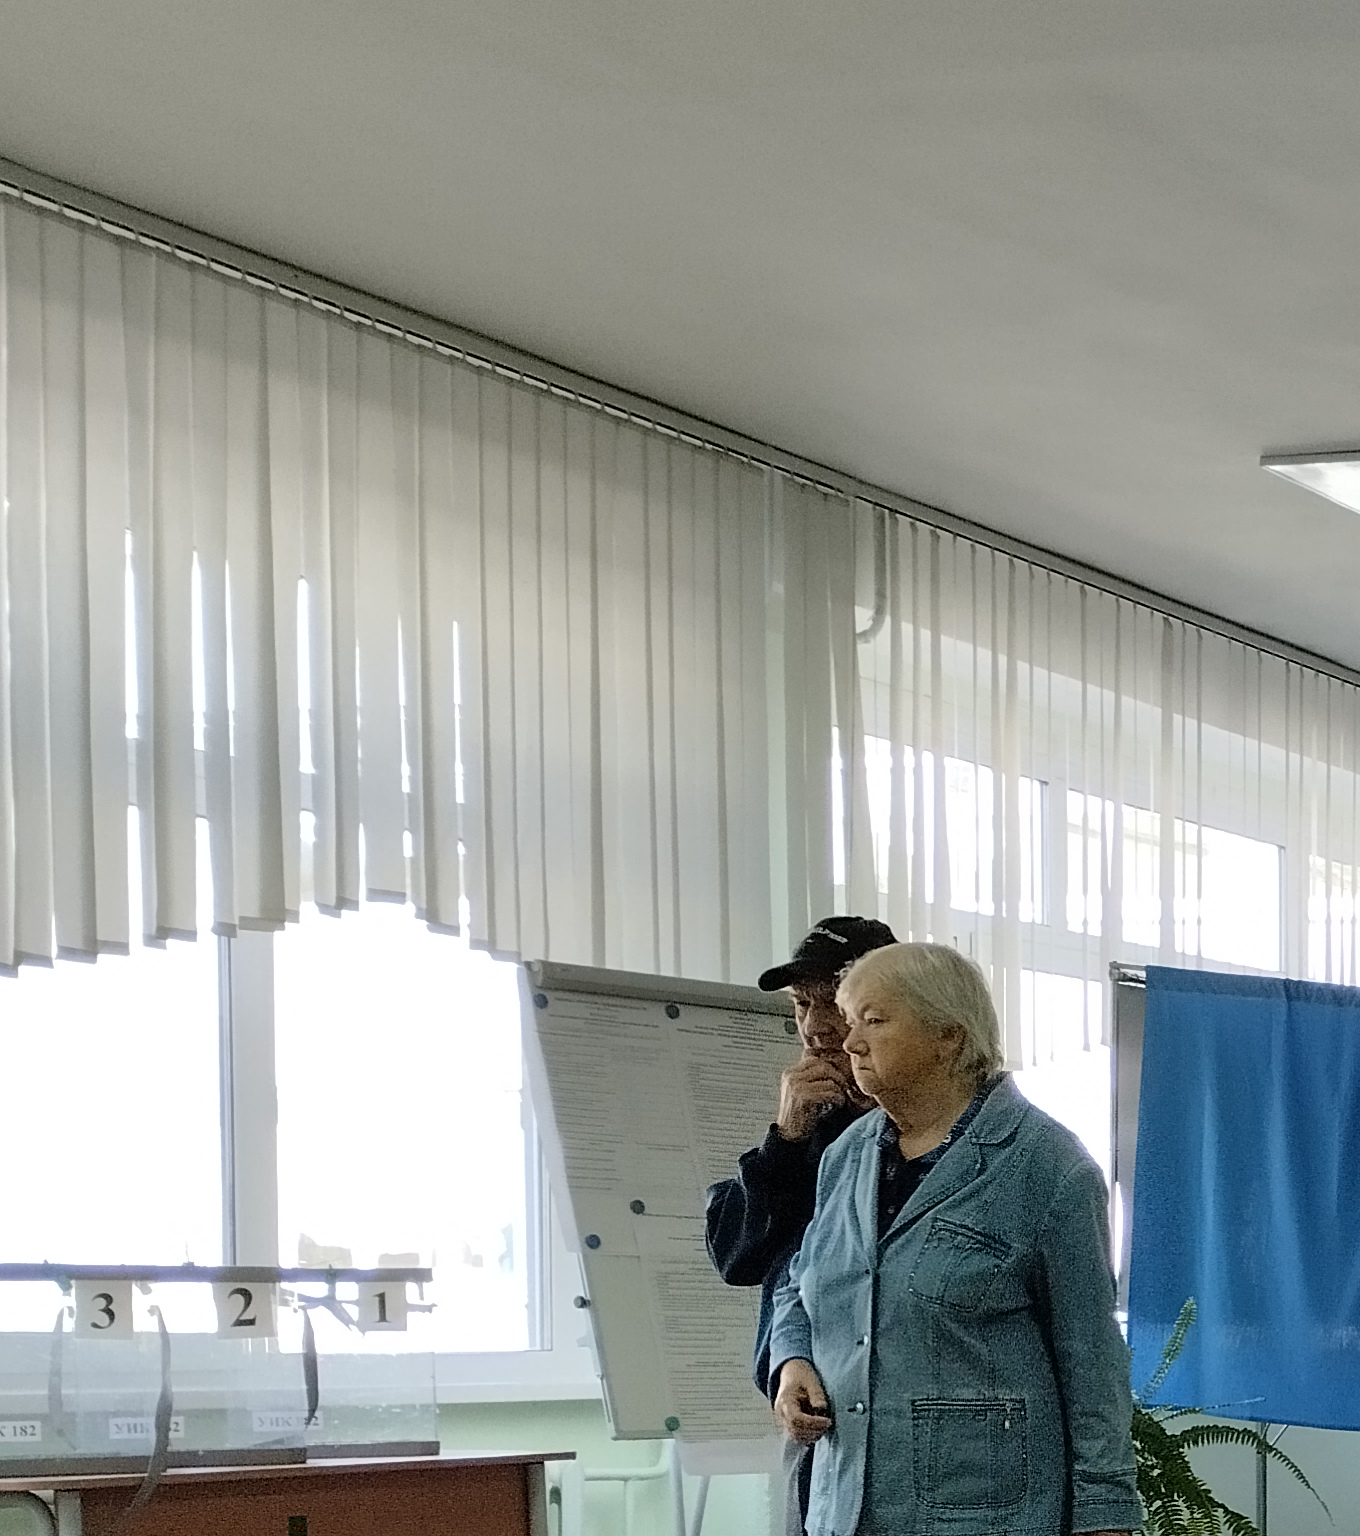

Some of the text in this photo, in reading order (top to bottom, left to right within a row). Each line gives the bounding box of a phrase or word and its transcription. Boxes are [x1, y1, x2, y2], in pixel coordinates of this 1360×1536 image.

[90, 1292, 116, 1330] 3
[227, 1287, 257, 1328] 2
[373, 1291, 392, 1324] 1
[12, 1424, 36, 1437] 182
[258, 1416, 292, 1428] УИК
